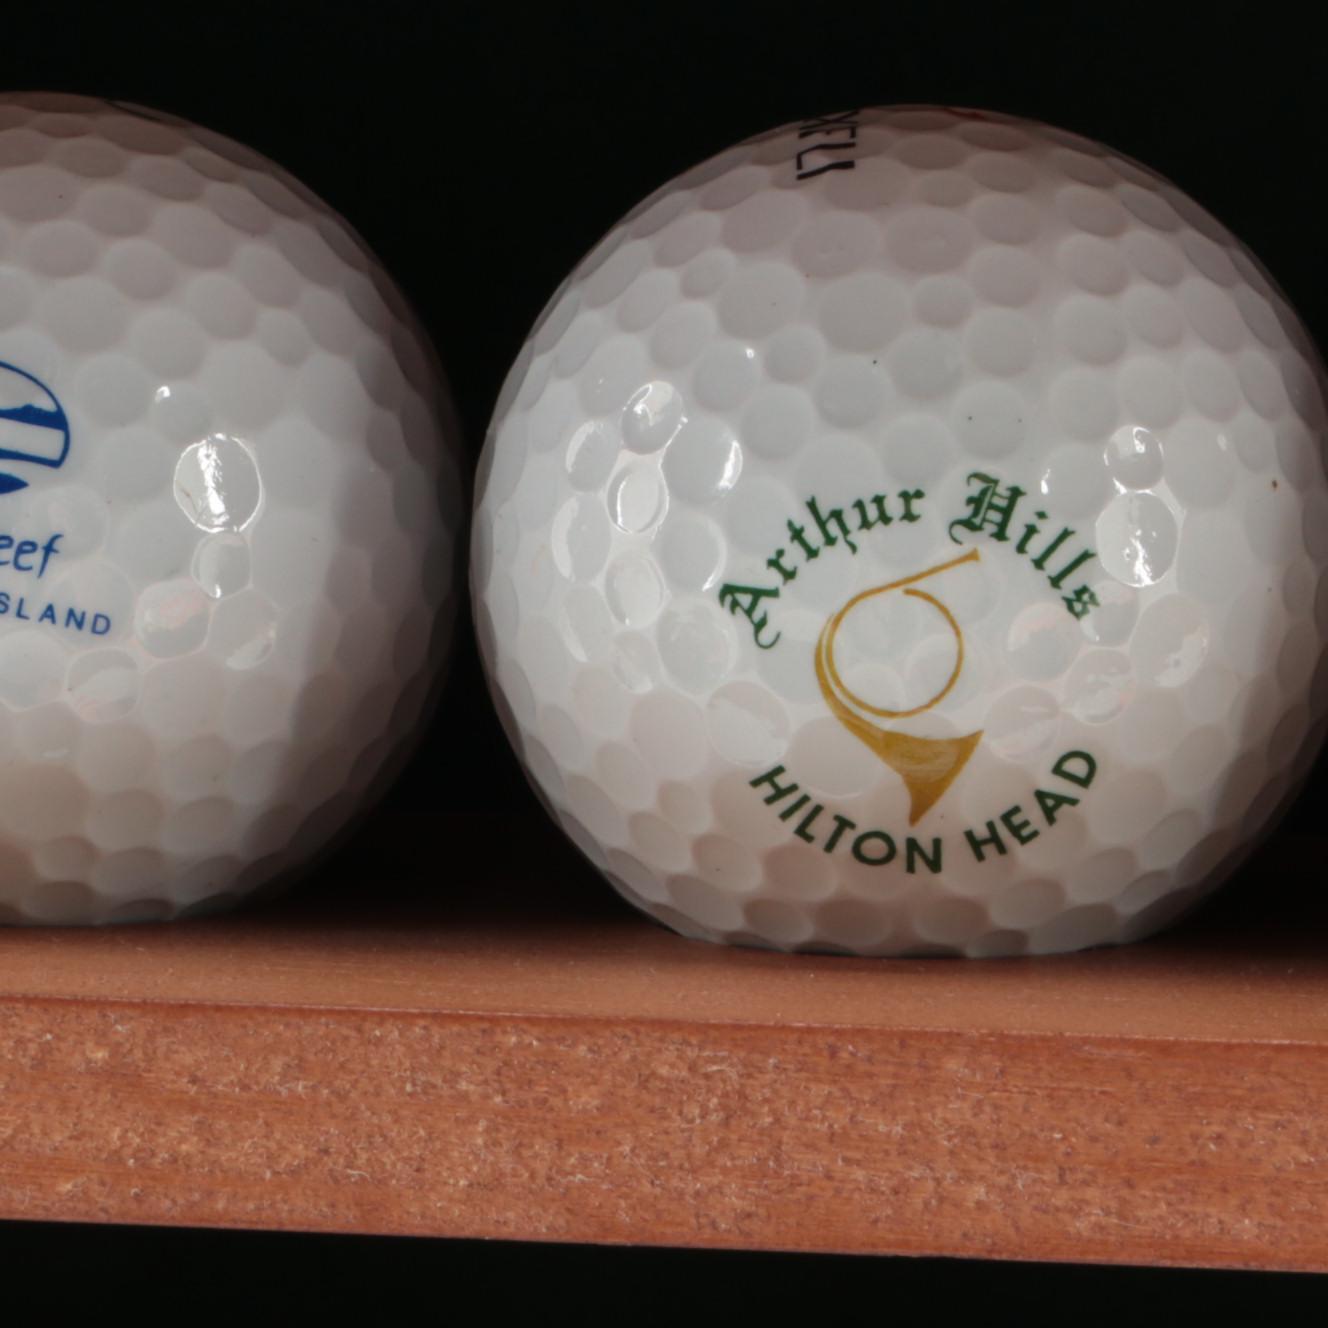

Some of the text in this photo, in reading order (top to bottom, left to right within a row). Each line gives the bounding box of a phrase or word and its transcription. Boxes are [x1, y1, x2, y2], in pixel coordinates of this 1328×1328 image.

[718, 471, 1101, 650] Arthur Hills
[749, 749, 1098, 874] HILTON HEAD
